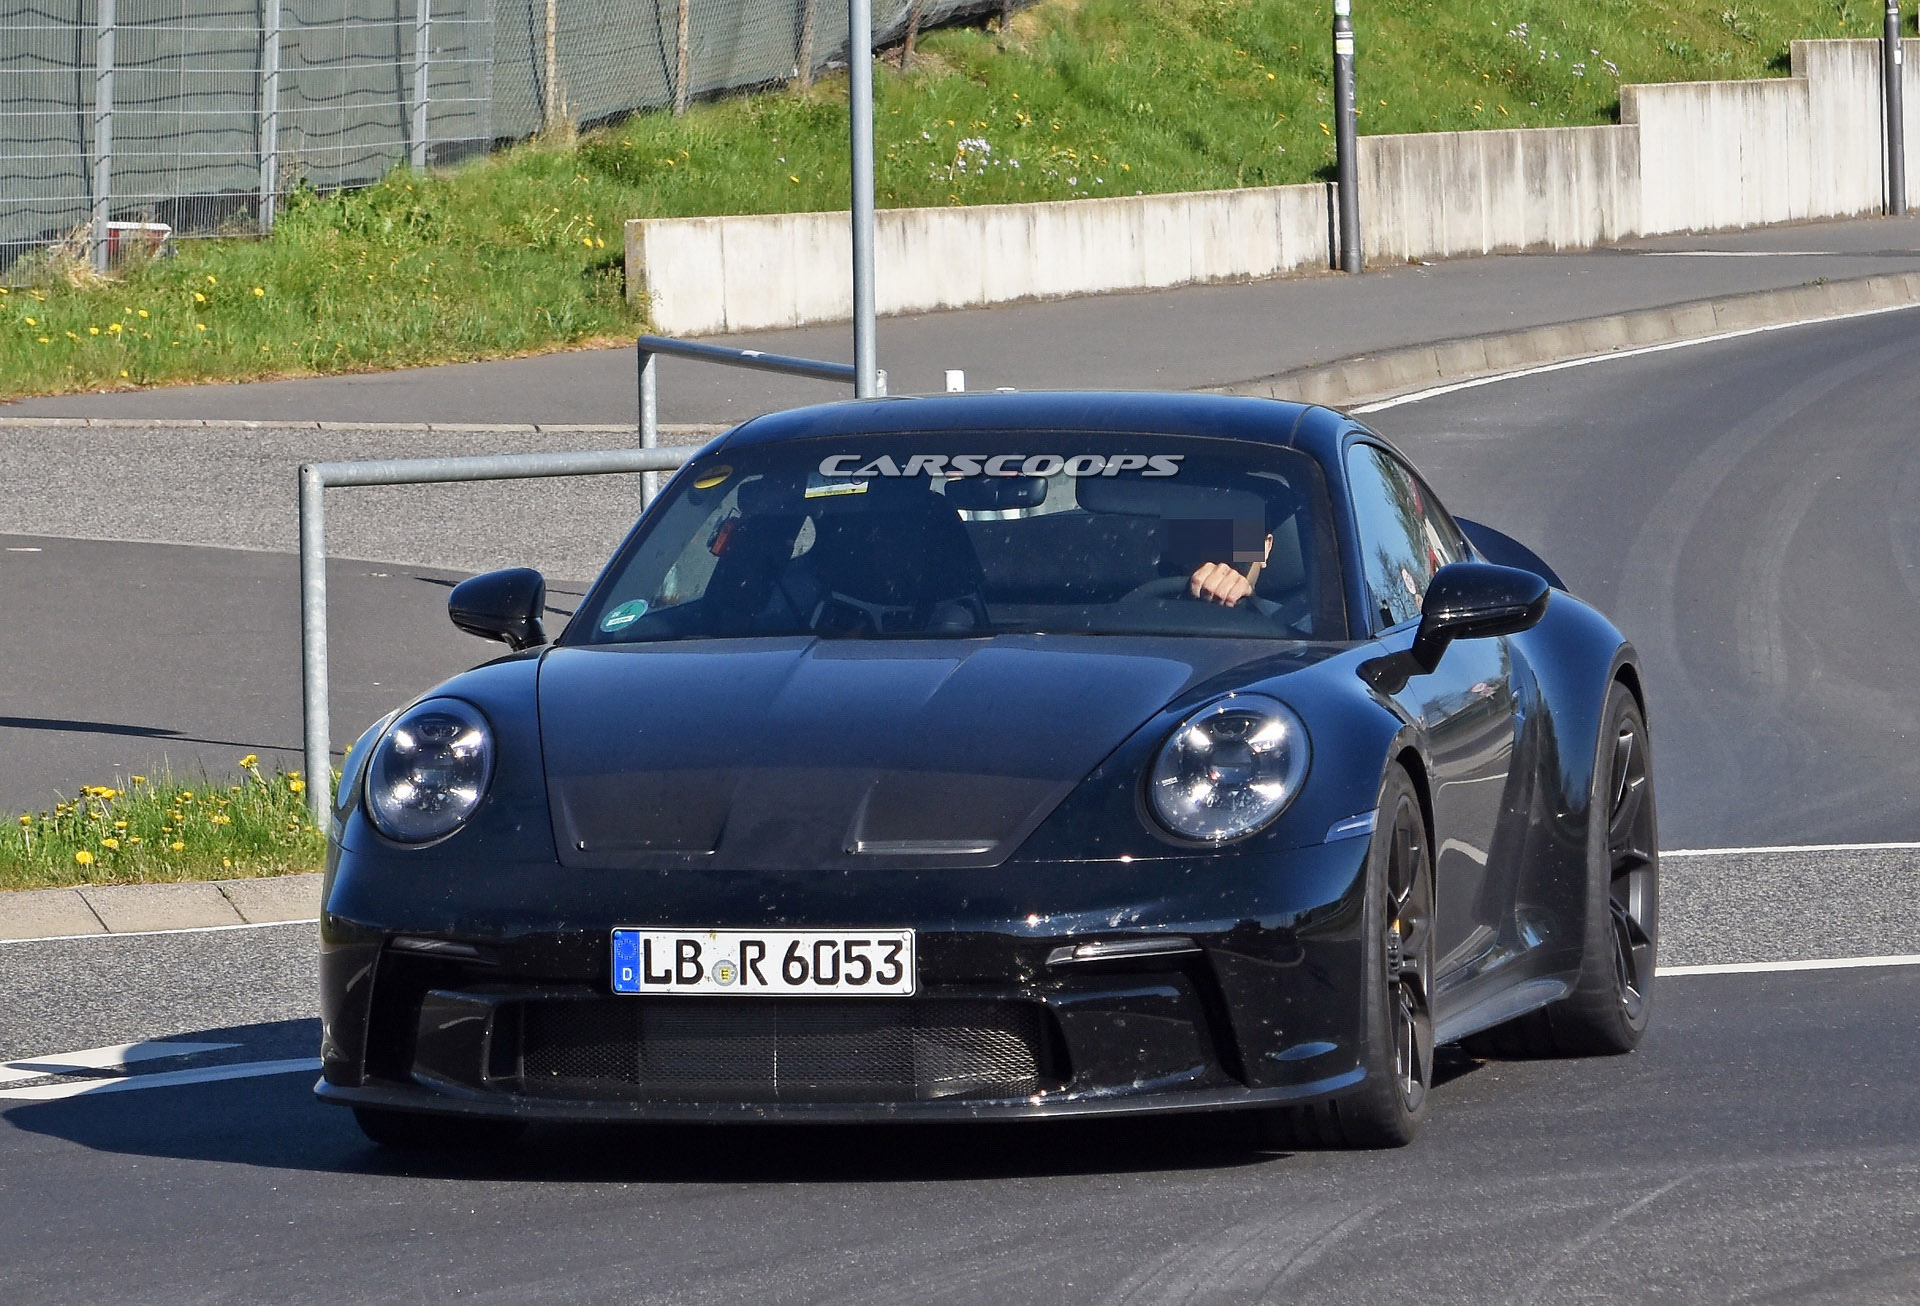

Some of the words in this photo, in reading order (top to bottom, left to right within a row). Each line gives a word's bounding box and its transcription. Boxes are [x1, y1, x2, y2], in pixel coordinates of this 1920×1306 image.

[622, 967, 632, 981] D
[643, 938, 704, 985] LB
[739, 940, 768, 986] R
[782, 939, 903, 986] 6053
